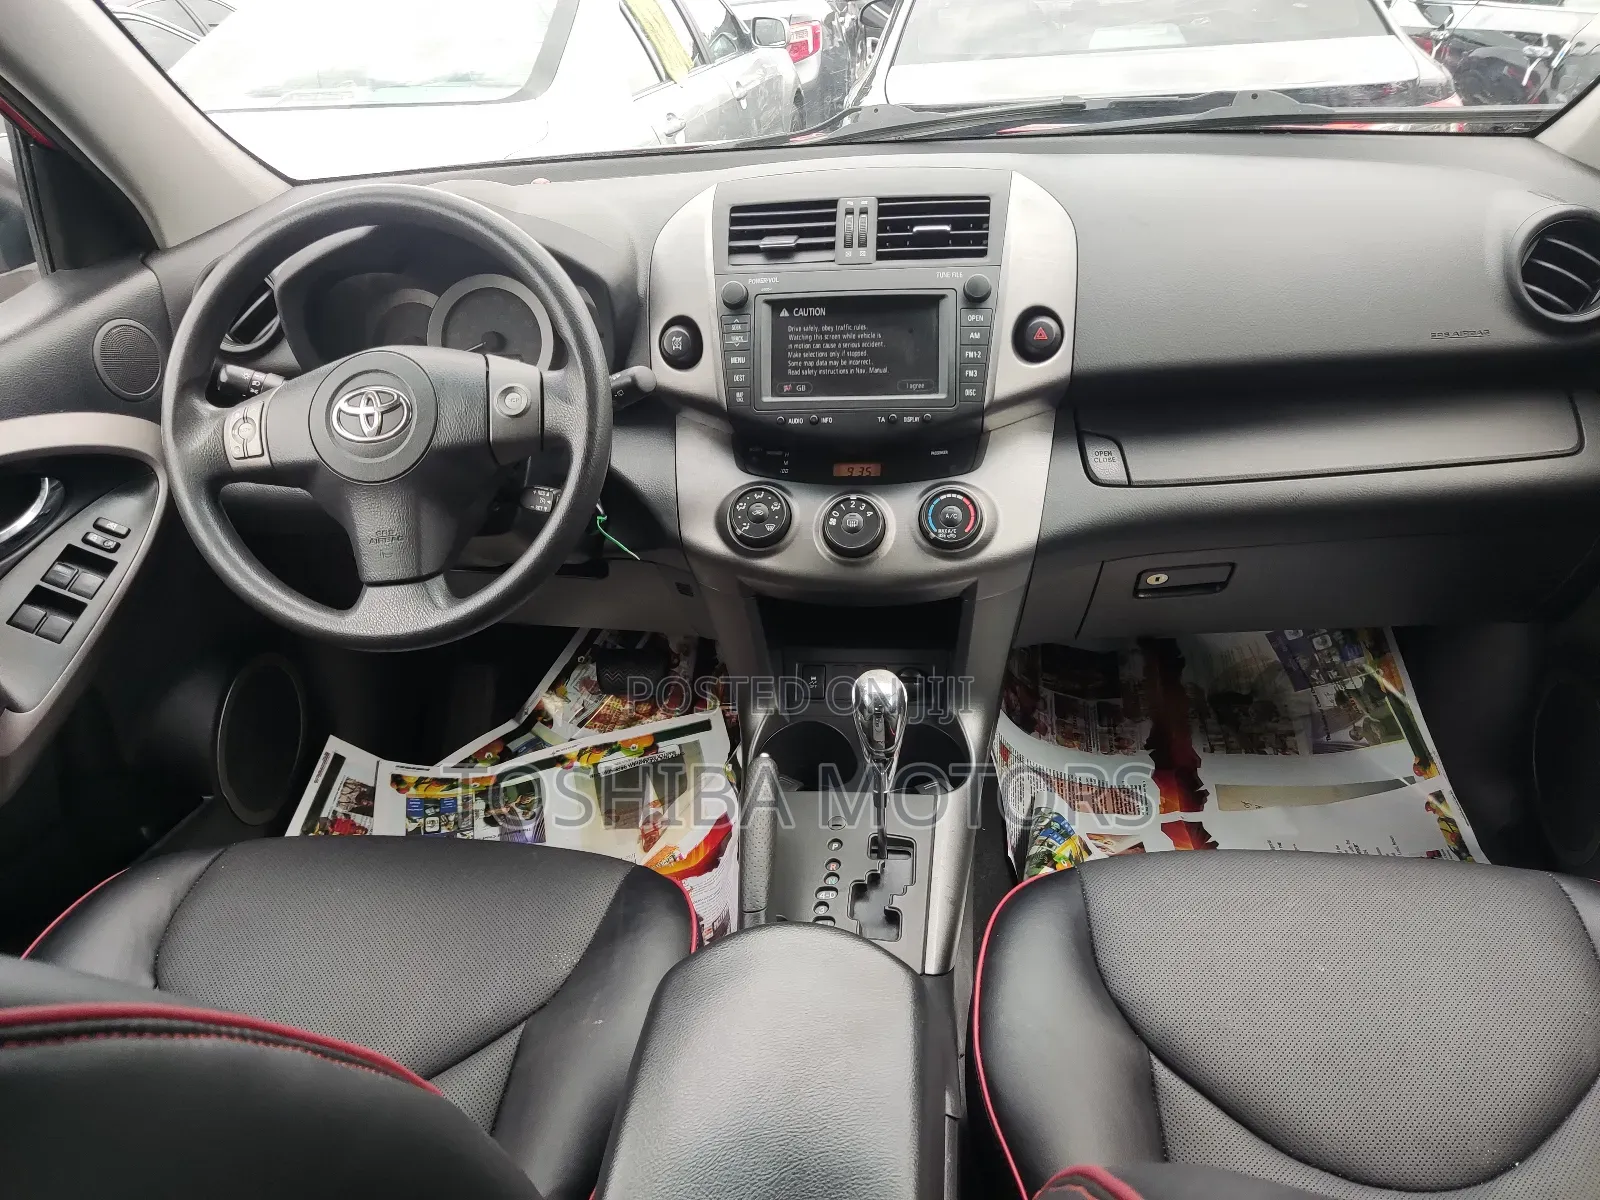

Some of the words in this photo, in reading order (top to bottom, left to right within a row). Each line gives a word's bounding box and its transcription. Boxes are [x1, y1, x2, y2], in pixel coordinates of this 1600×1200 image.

[793, 307, 826, 317] CAUTION
[967, 314, 984, 322] OPEN
[821, 324, 834, 332] obey
[788, 334, 812, 342] Watching
[829, 350, 840, 358] only
[730, 356, 746, 364] MENU
[802, 368, 818, 376] safety
[818, 367, 848, 376] instructions
[965, 369, 978, 378] FM3
[733, 374, 746, 382] DEST
[910, 383, 925, 391] agree
[964, 388, 977, 397] DISC
[860, 502, 866, 510] 3
